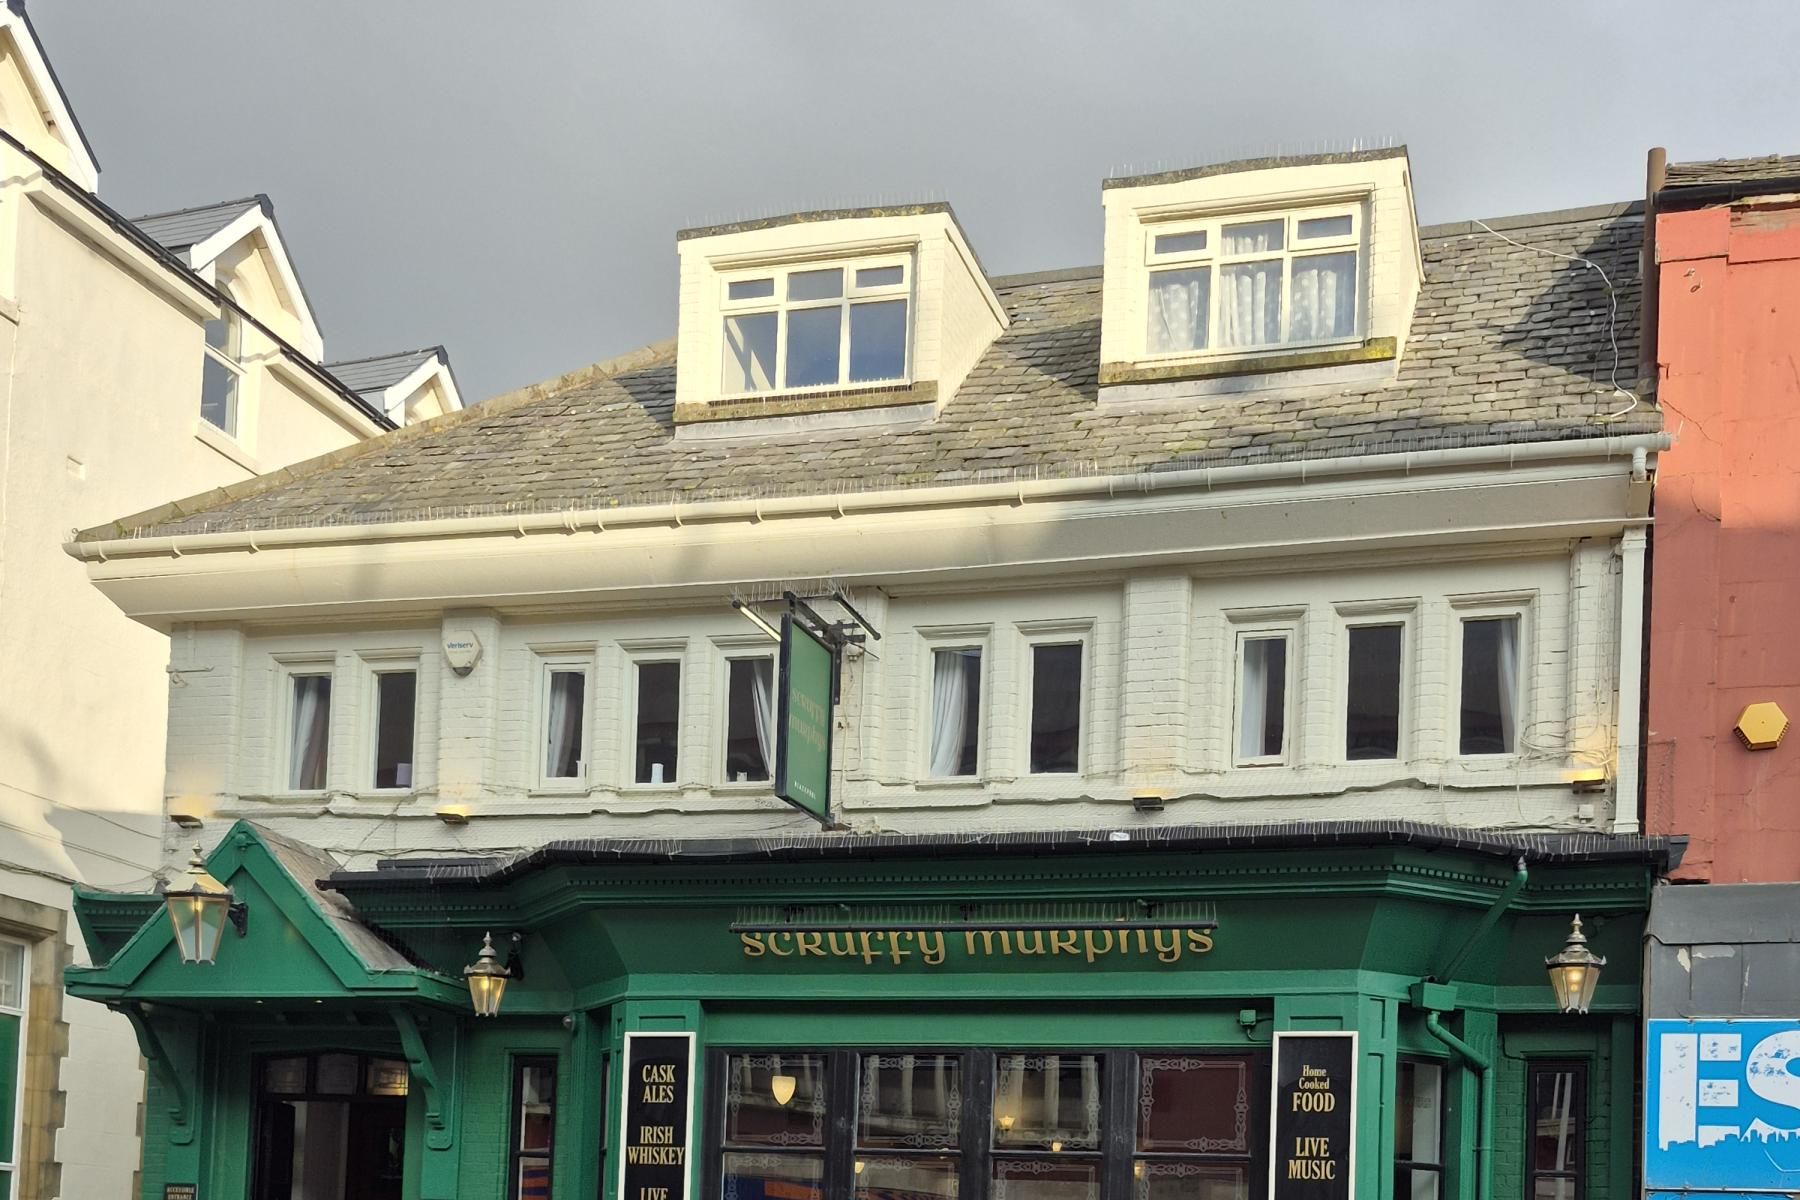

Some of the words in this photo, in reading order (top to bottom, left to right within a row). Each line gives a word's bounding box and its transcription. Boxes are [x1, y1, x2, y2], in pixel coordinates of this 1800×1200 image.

[642, 1064, 676, 1083] CASK
[1303, 1064, 1327, 1077] Home
[1299, 1077, 1330, 1090] Cooked
[642, 1085, 674, 1103] ALES
[1292, 1092, 1335, 1112] FOOD
[640, 1126, 673, 1144] IRISH
[627, 1146, 685, 1165] WHISKEY
[1295, 1137, 1329, 1157] LIVE
[1288, 1159, 1336, 1180] MUSIC
